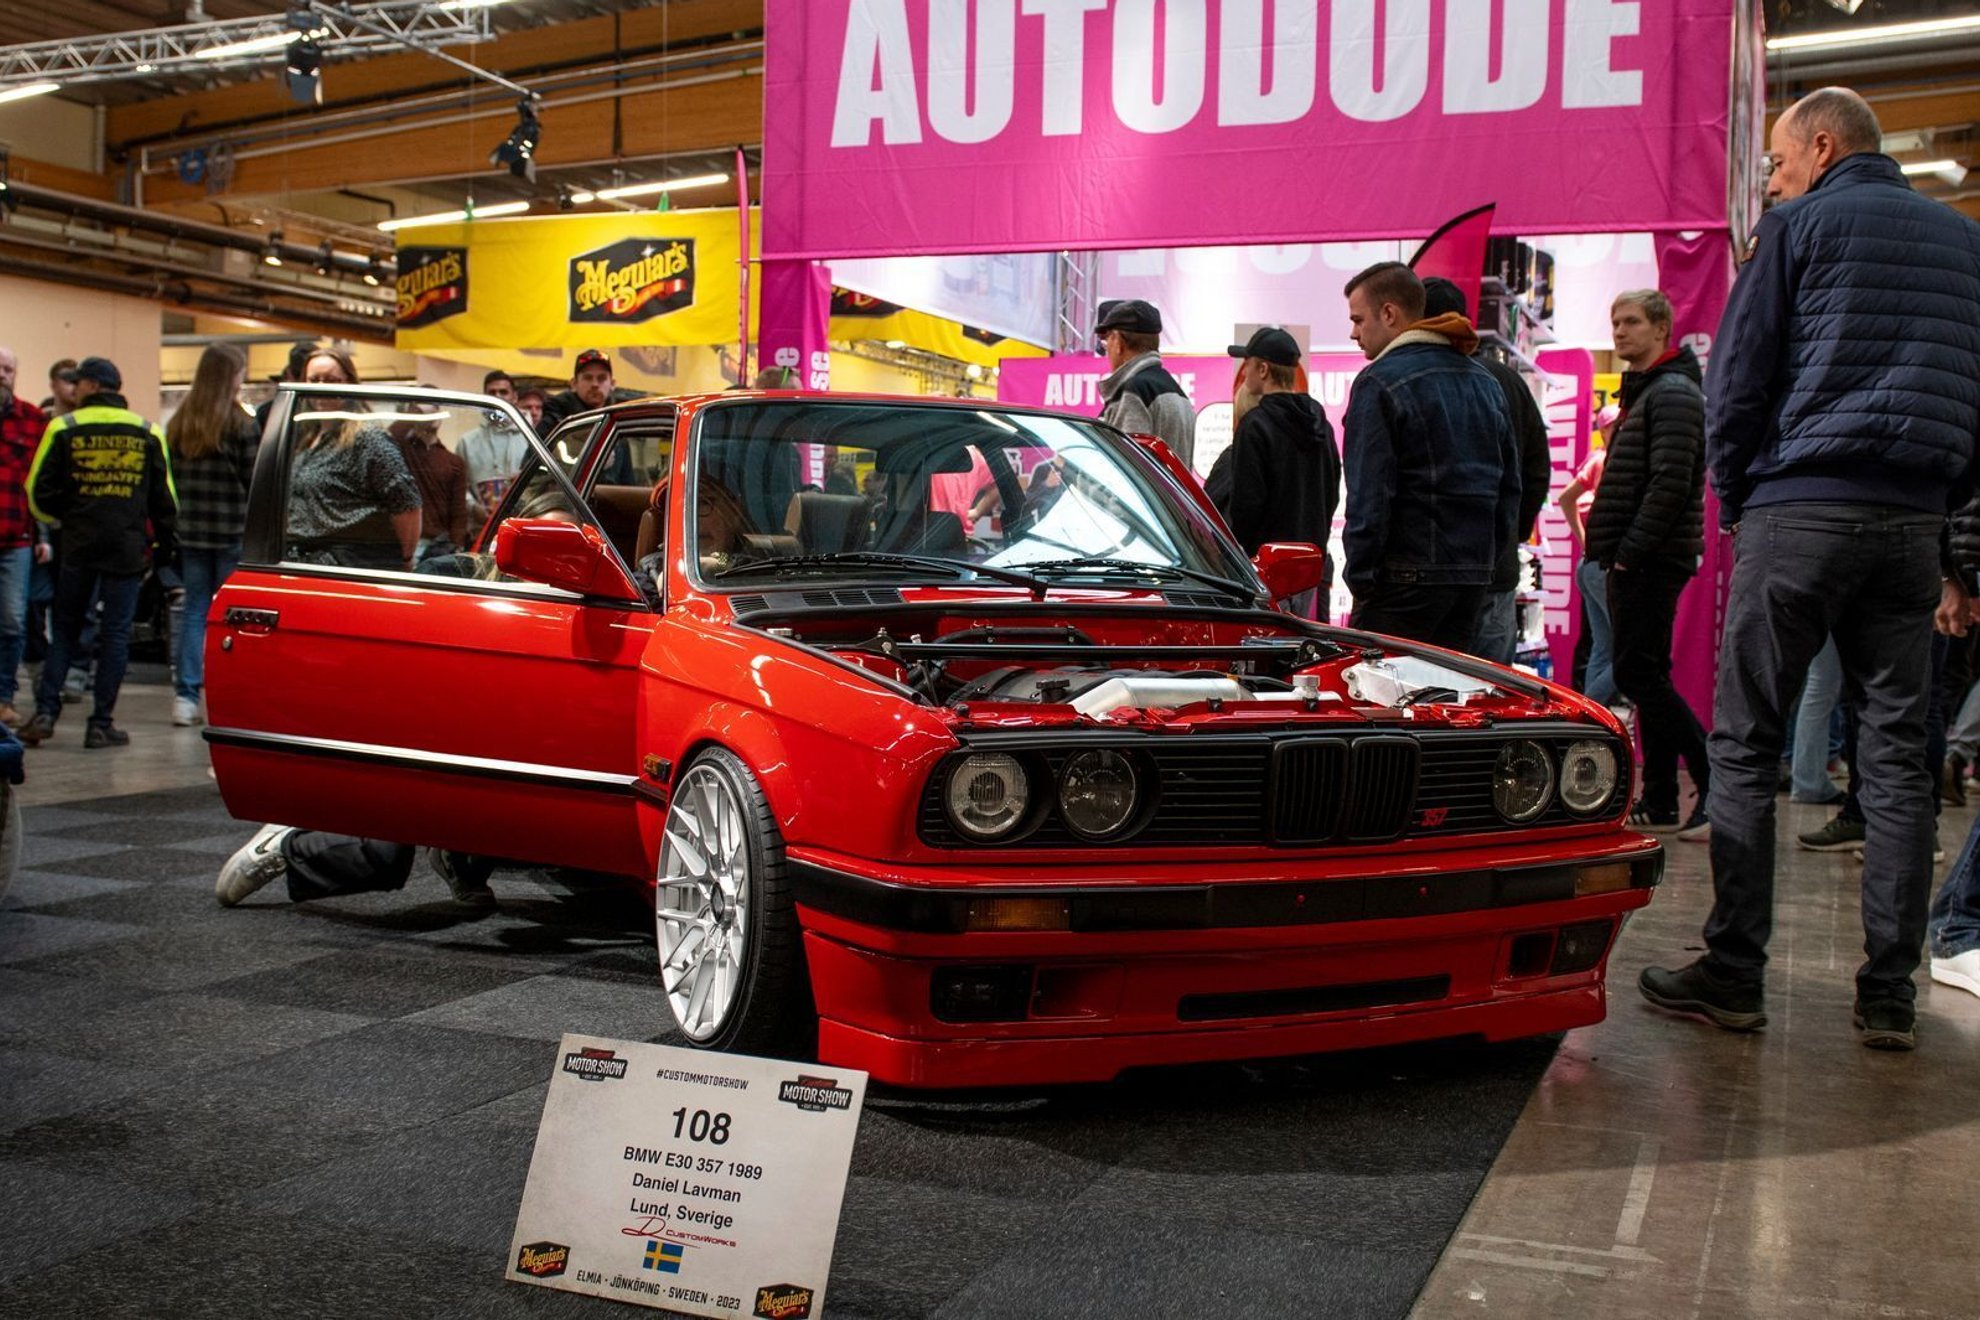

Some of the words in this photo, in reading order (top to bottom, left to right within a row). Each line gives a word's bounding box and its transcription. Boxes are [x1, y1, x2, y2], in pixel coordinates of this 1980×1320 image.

[831, 0, 1643, 148] AUTODUDE
[575, 241, 688, 316] Meguiar's
[656, 1069, 749, 1090] #CUSTOMMOTORSHOW
[672, 1106, 732, 1145] 108
[623, 1146, 662, 1164] BMW
[665, 1152, 693, 1170] E30
[696, 1157, 724, 1174] 357
[728, 1162, 763, 1180] 1989
[632, 1172, 680, 1193] Daniel
[682, 1180, 742, 1203] Lavman
[630, 1198, 672, 1220] Lund,
[676, 1205, 733, 1230] Sverige
[520, 1247, 566, 1273] Meguiar's
[576, 1270, 601, 1285] ELMIA
[610, 1274, 660, 1296] JÖNKÖPING
[668, 1286, 708, 1304] SWEDEN
[716, 1295, 741, 1310] 2023
[757, 1289, 809, 1317] Meguiar's
